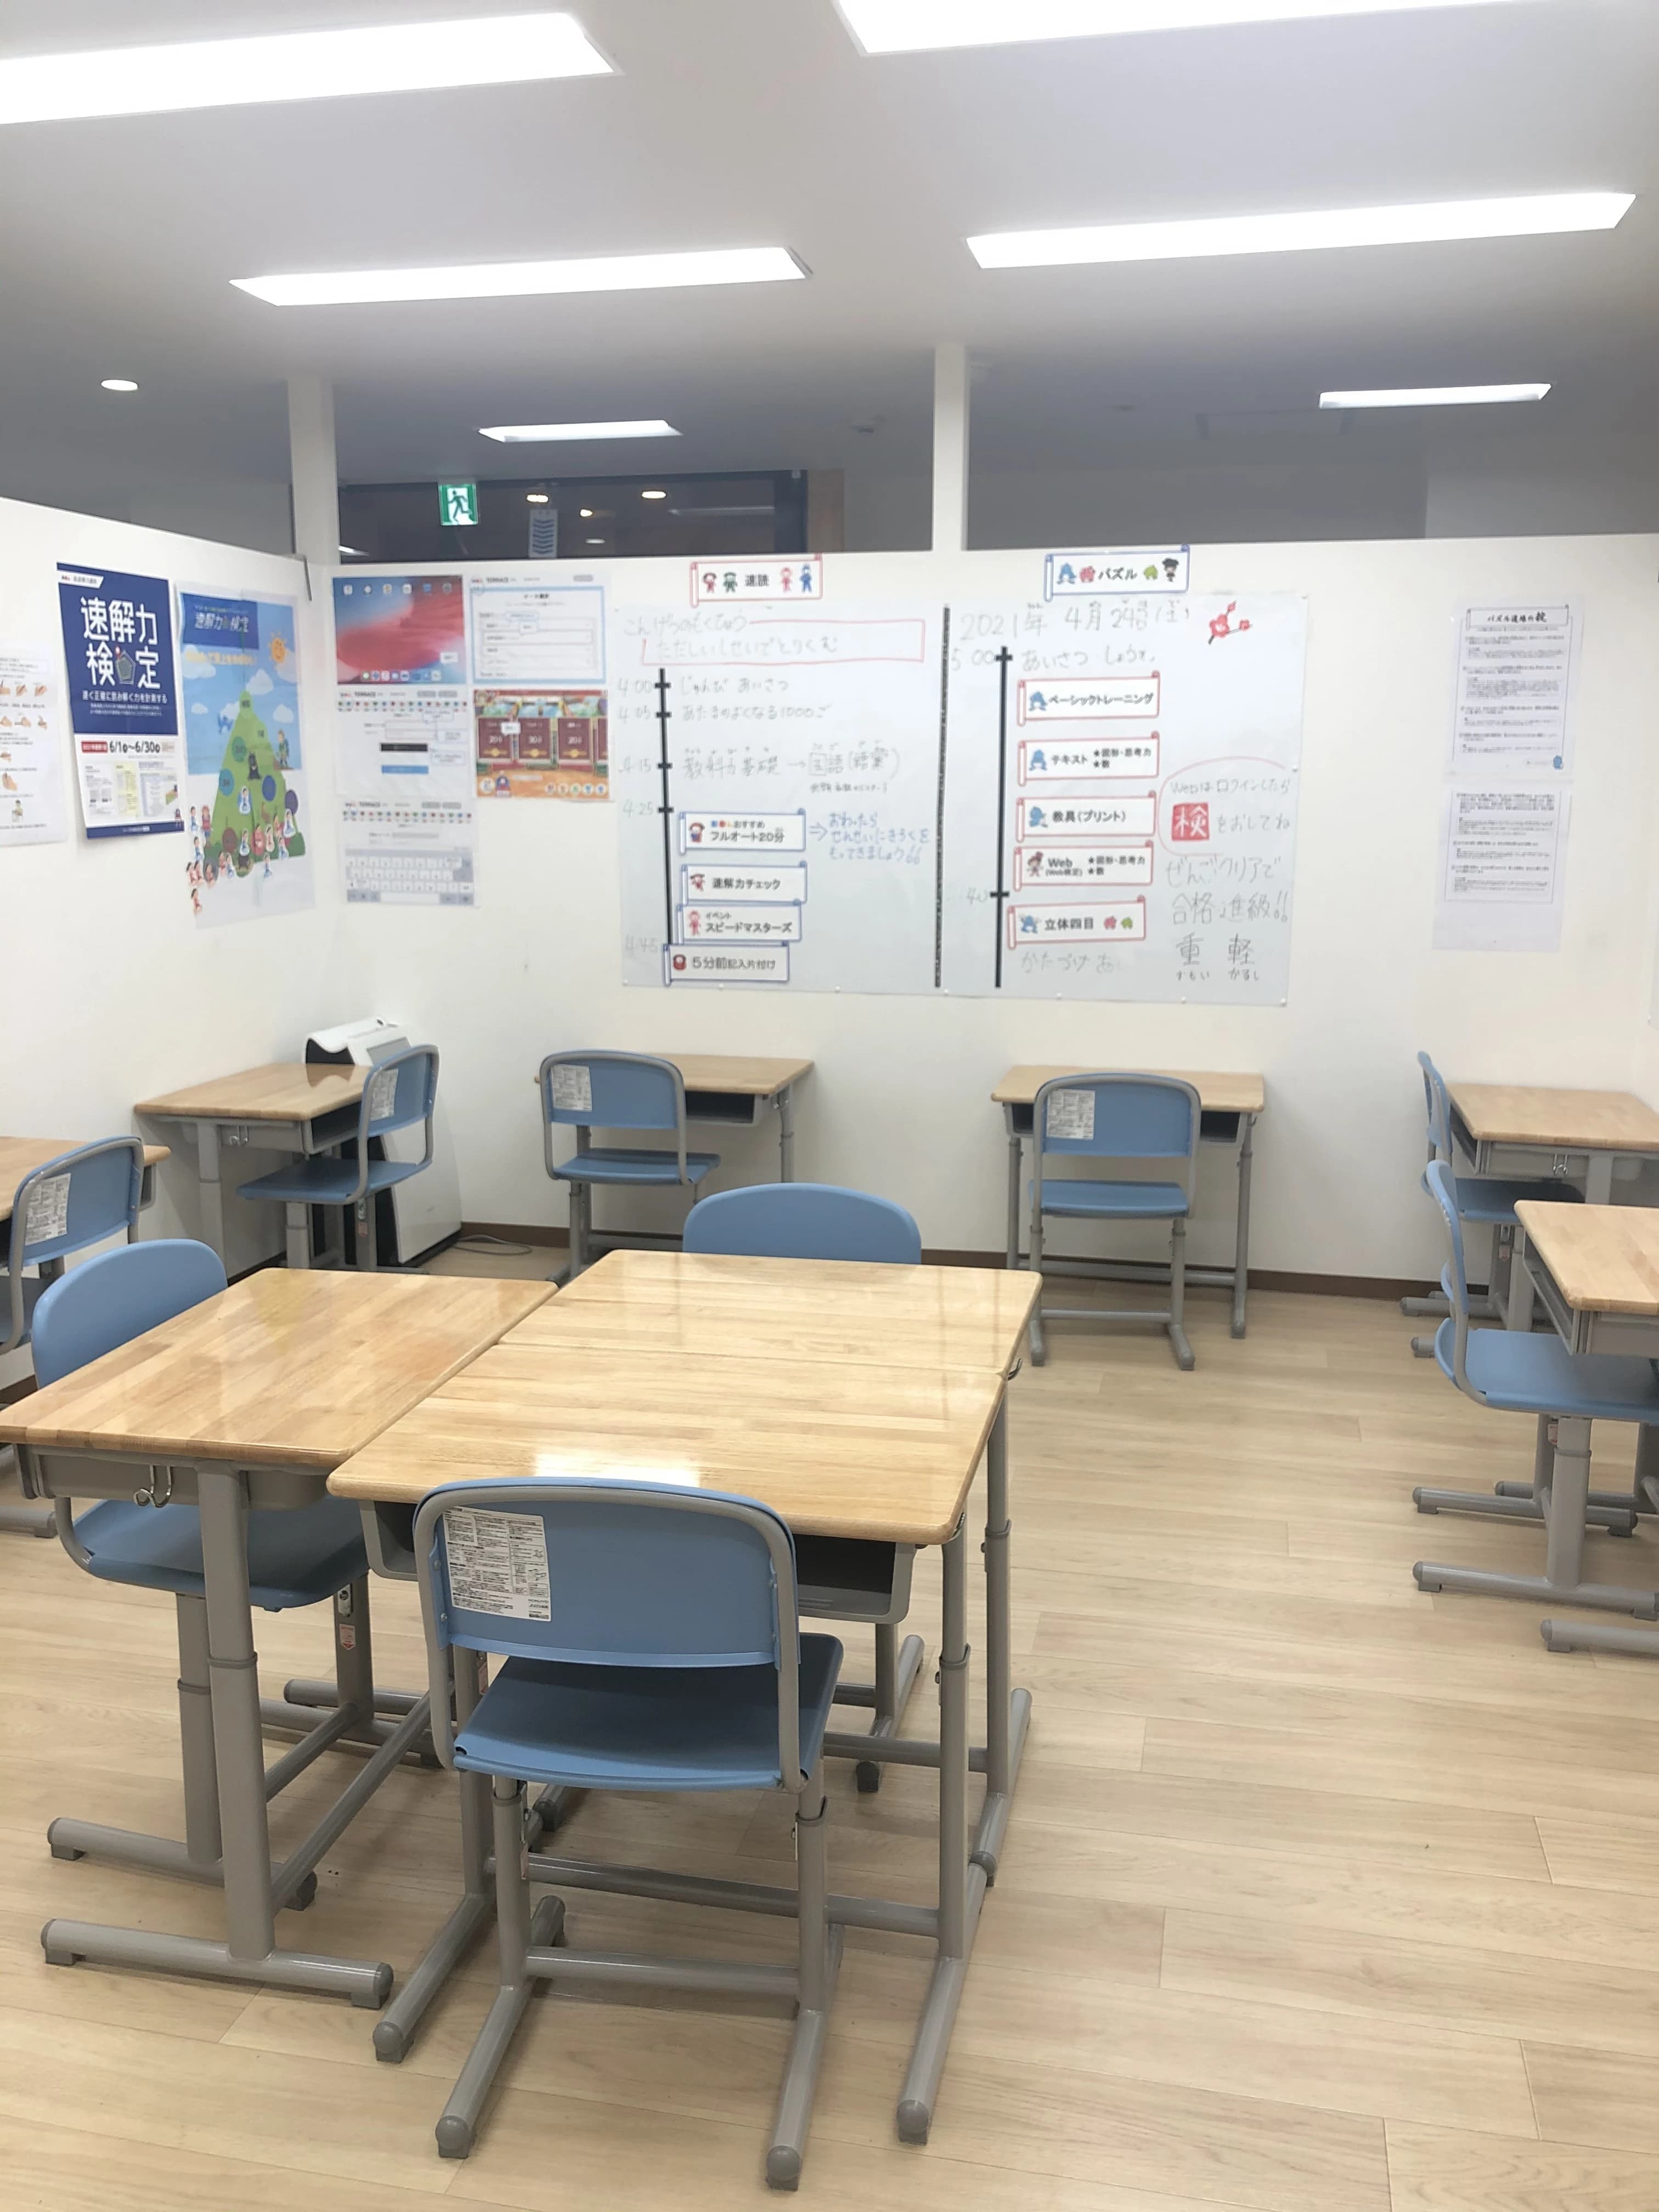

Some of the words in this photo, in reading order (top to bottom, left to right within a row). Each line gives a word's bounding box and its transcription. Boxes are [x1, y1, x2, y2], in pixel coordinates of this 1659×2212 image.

[1098, 567, 1138, 580] パズル
[80, 596, 158, 646] 速解力
[1048, 692, 1154, 706] ベーシックトレーニング
[1051, 754, 1088, 765] テキスト
[710, 830, 785, 843] フルオート20分
[1048, 857, 1073, 868] Web
[712, 878, 781, 890] 速解力チェック
[706, 911, 732, 920] イベント
[706, 921, 793, 934] スピードマスターズ
[1044, 917, 1094, 931] 立体四目
[1176, 932, 1204, 966] 重
[1227, 933, 1255, 966] 軽
